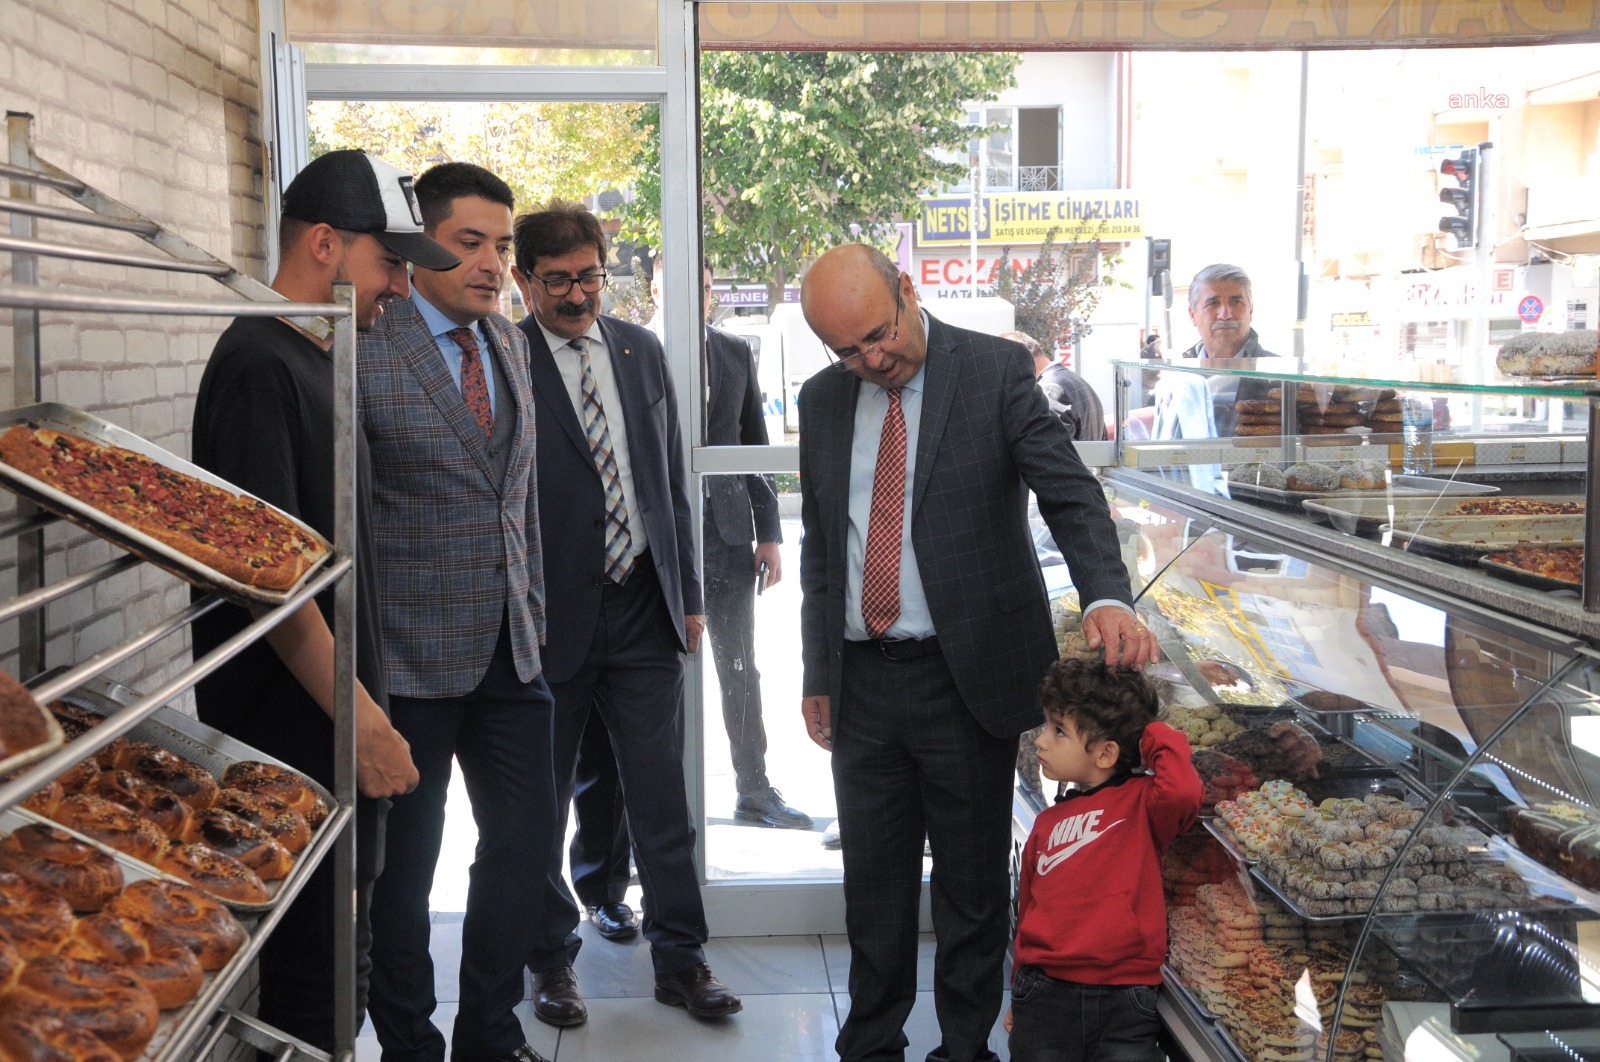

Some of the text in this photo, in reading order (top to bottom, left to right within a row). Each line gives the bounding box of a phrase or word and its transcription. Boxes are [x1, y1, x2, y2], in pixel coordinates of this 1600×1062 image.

[995, 197, 1139, 225] İŞİTME CİHAZLARI
[995, 228, 1014, 237] SATIŞ
[1016, 227, 1025, 236] VE
[1111, 225, 1122, 233] 213
[1123, 224, 1132, 233] 24
[1132, 224, 1141, 233] 36
[1496, 273, 1510, 288] E
[719, 291, 792, 303] MENEKE
[1048, 809, 1104, 851] NIKE
